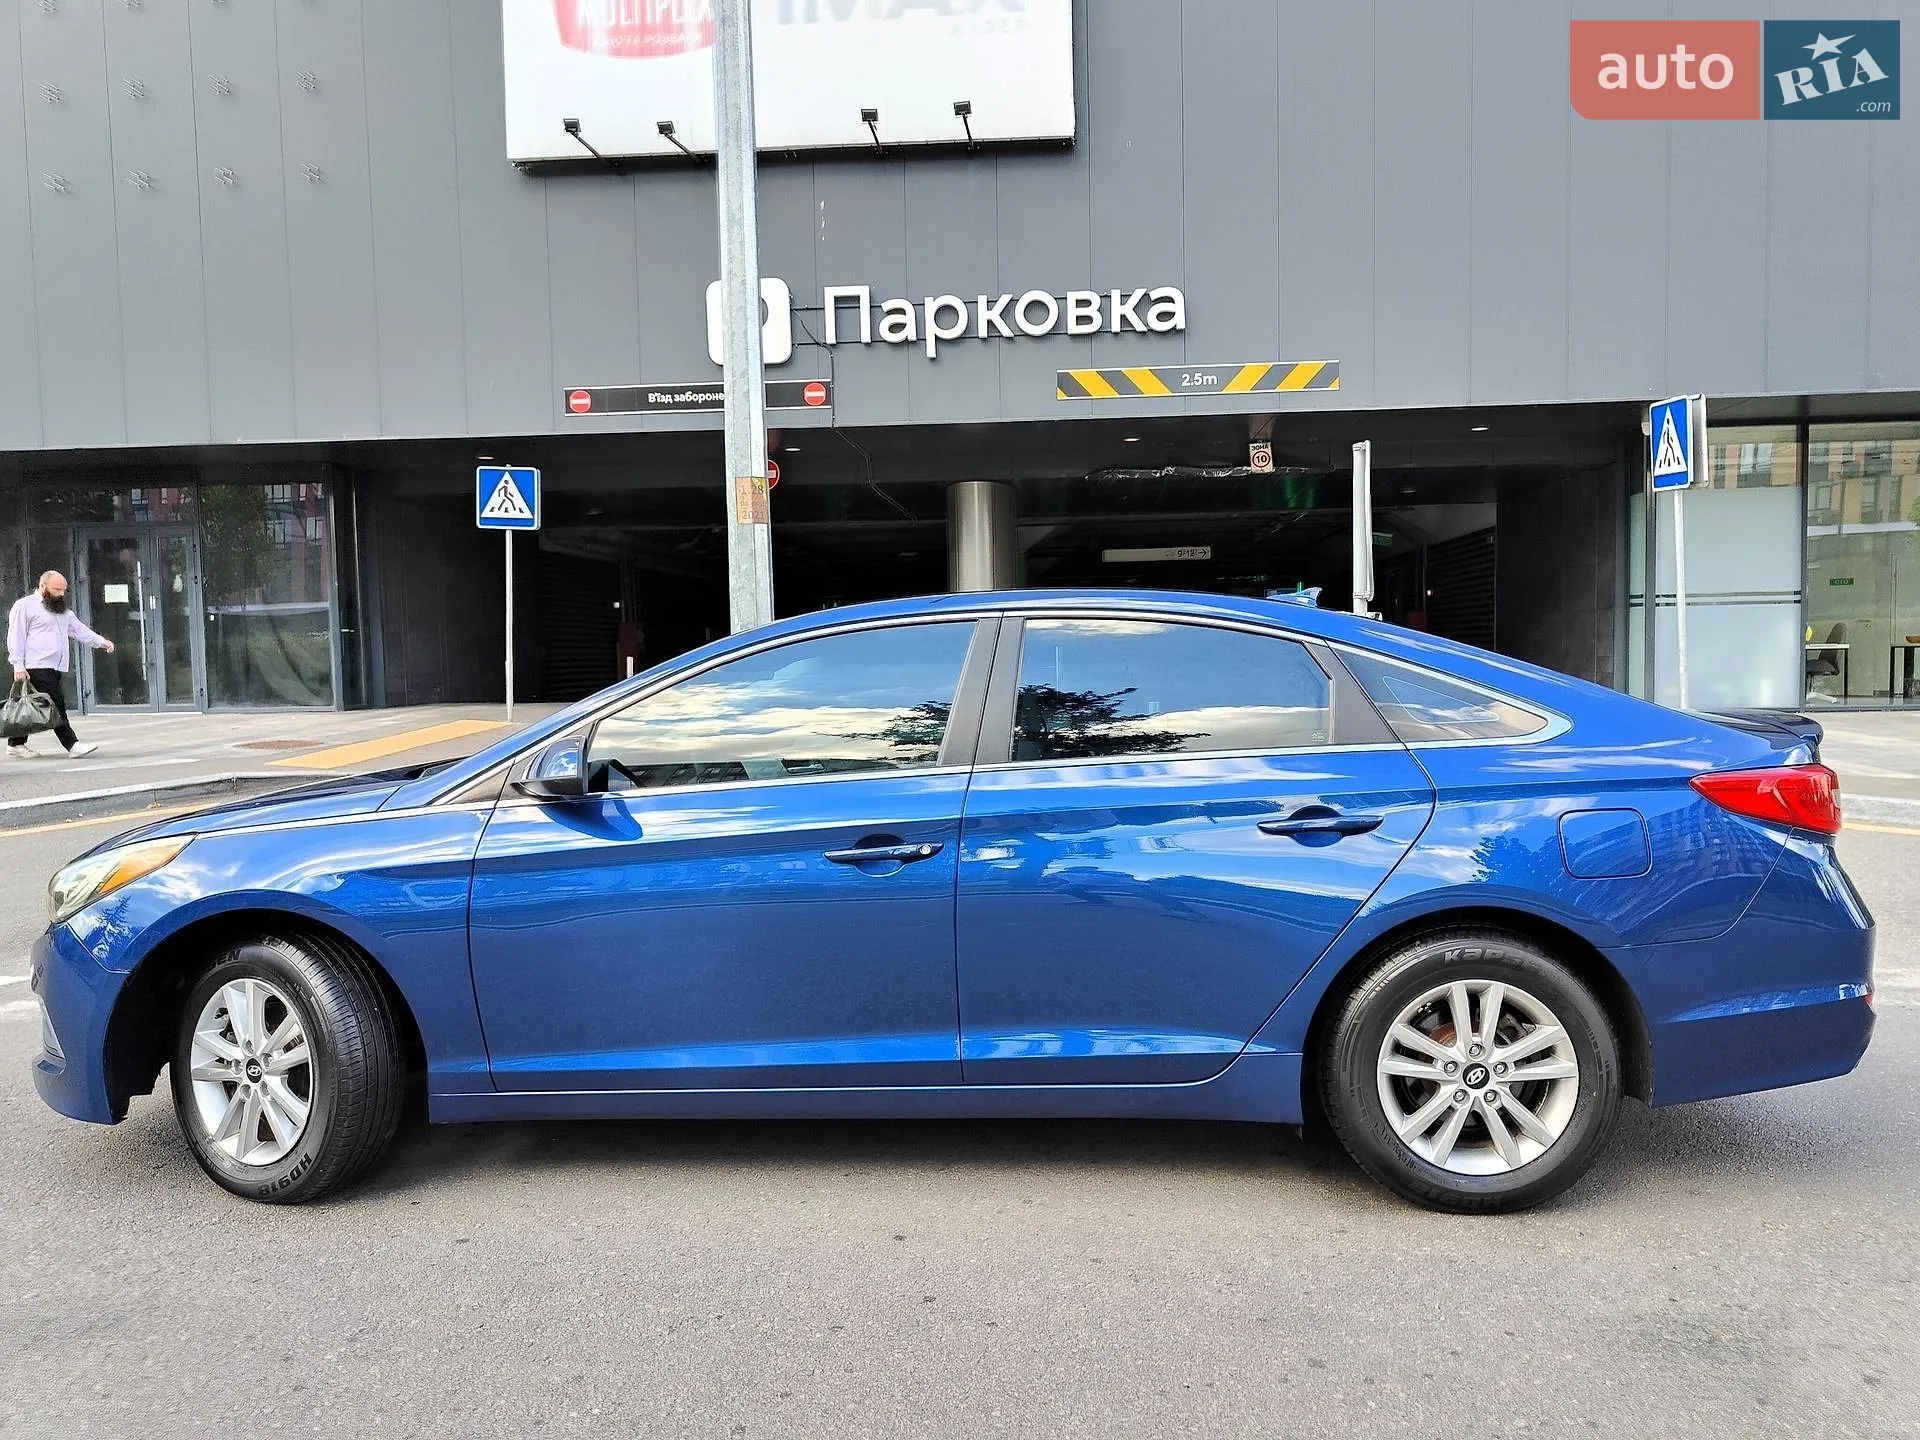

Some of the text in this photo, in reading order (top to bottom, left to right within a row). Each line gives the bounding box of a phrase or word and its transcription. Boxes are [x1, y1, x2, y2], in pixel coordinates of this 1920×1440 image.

[824, 284, 1186, 359] Парковка
[1181, 372, 1218, 386] 2.5m
[674, 391, 725, 404] забороне
[1255, 454, 1268, 464] 10
